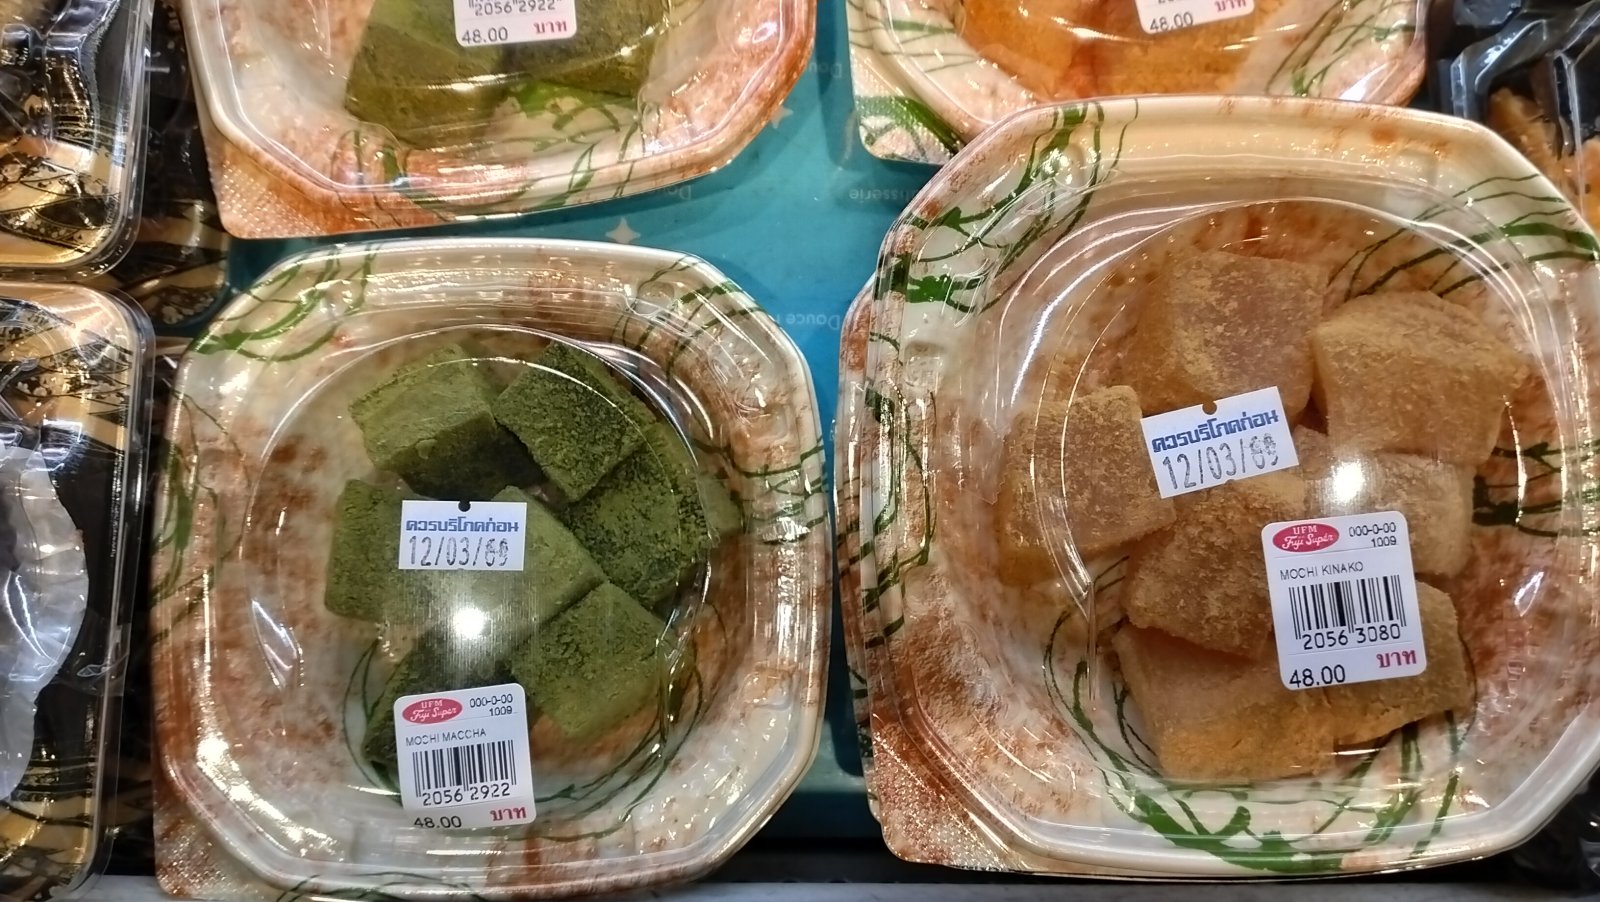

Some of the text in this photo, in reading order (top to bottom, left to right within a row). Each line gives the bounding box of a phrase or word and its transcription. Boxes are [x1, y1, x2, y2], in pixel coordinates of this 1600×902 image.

[475, 0, 555, 16] 2056 2922
[1150, 12, 1194, 32] 48.00
[462, 21, 568, 44] 48.00 บาท
[786, 314, 840, 330] Douce
[1152, 410, 1279, 452] ควรบริโภคก่อน
[406, 516, 519, 532] ควรบริโภคก่อน
[1292, 525, 1318, 534] UFM
[1348, 522, 1396, 538] 000-0-00
[1282, 533, 1334, 550] Fuji Super
[1371, 536, 1397, 548] 1009
[1280, 561, 1364, 580] MOCHI KINAKO
[1302, 624, 1401, 650] 2056 3080
[1289, 649, 1417, 688] 48.00 บาท
[420, 700, 443, 708] UFM
[470, 694, 513, 708] 000-0-00
[410, 707, 457, 722] Fuji Super
[489, 706, 513, 717] 1009
[406, 728, 486, 746] MOCHI MACCHA
[422, 782, 510, 806] 2056 2922
[414, 806, 527, 829] 48.00 บาท
